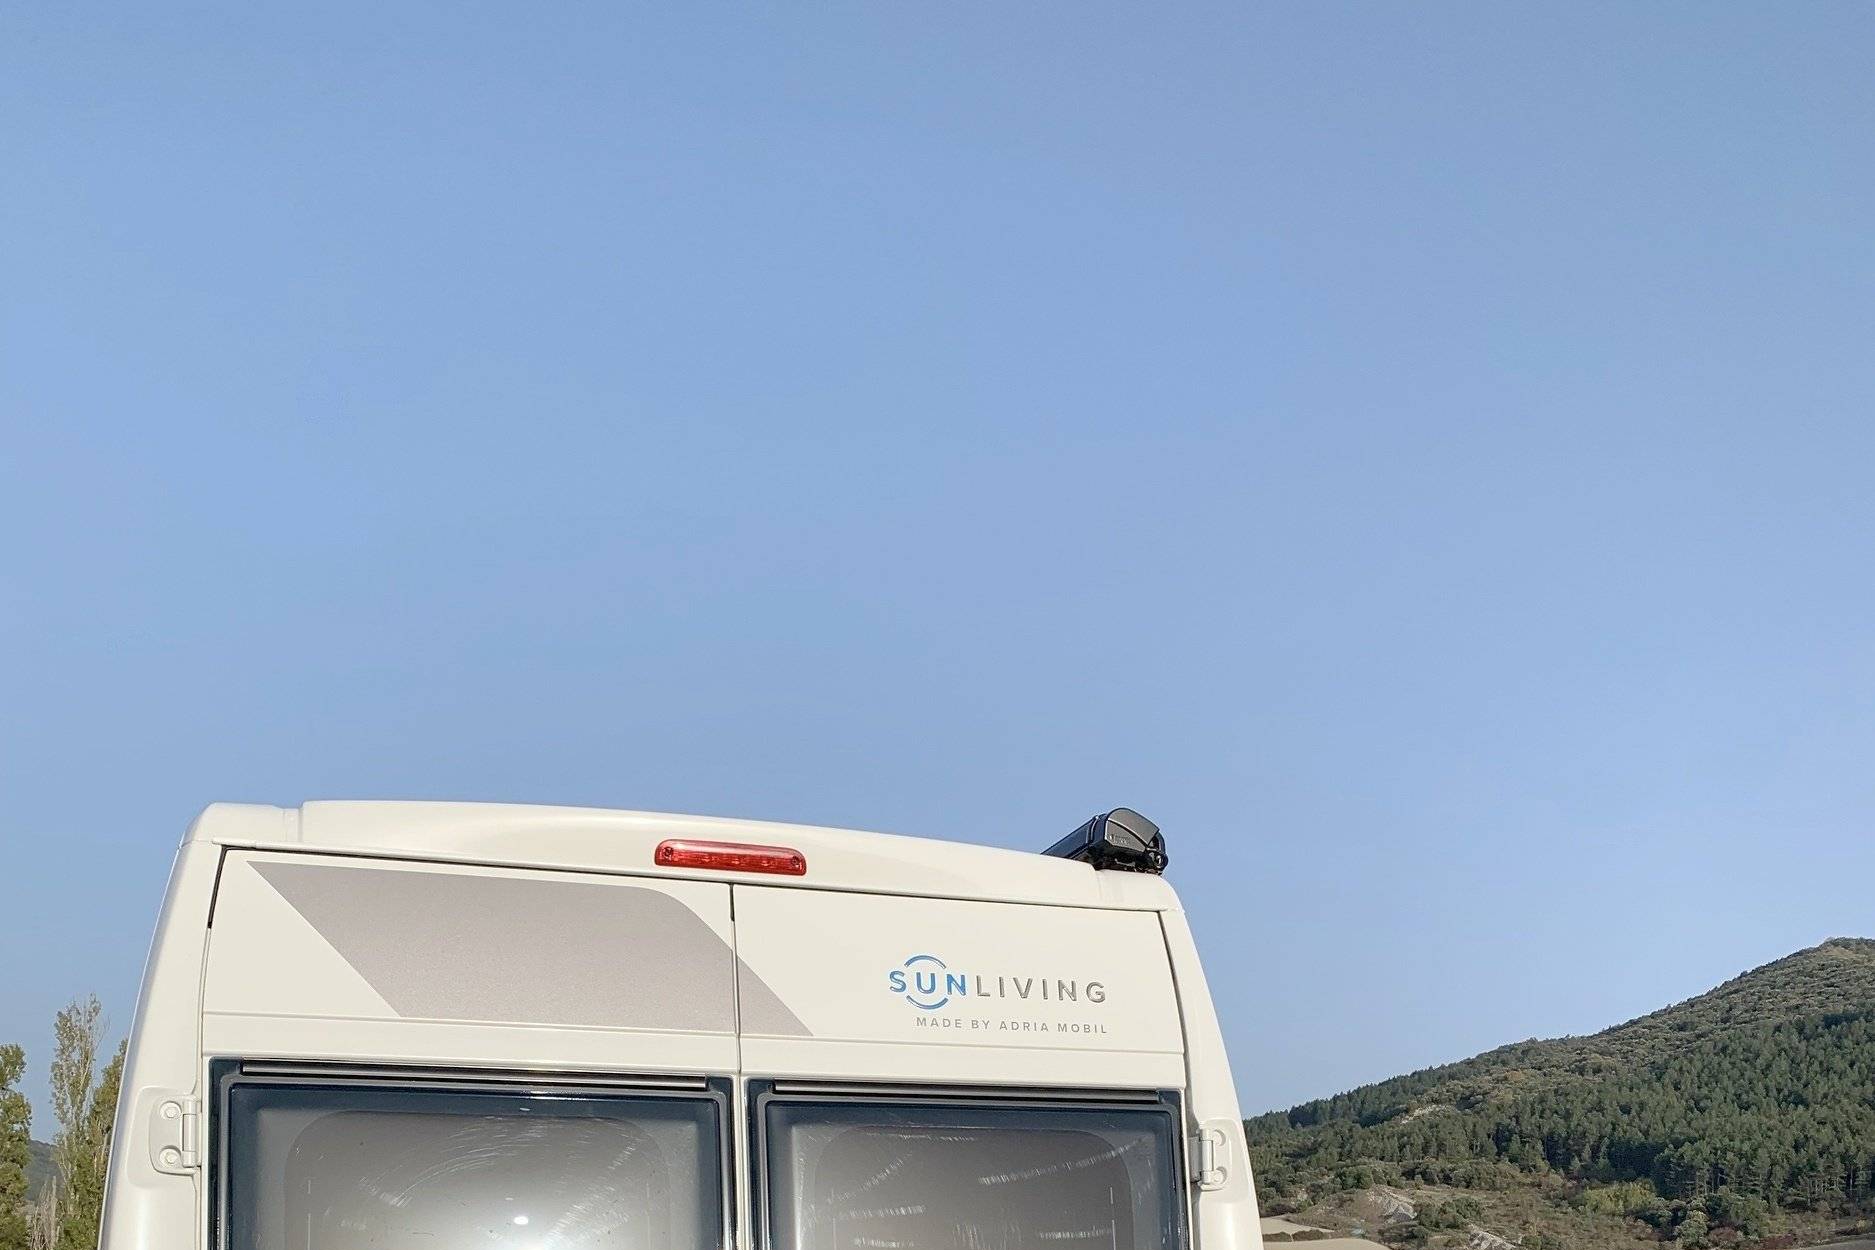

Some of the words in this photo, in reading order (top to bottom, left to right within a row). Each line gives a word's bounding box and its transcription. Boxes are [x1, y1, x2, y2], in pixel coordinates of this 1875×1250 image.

[888, 970, 1107, 1004] SUNLIVING
[916, 1017, 962, 1029] MADE
[971, 1019, 991, 1030] BY
[999, 1021, 1049, 1032] ADRIA
[1057, 1023, 1108, 1034] MOBIL
